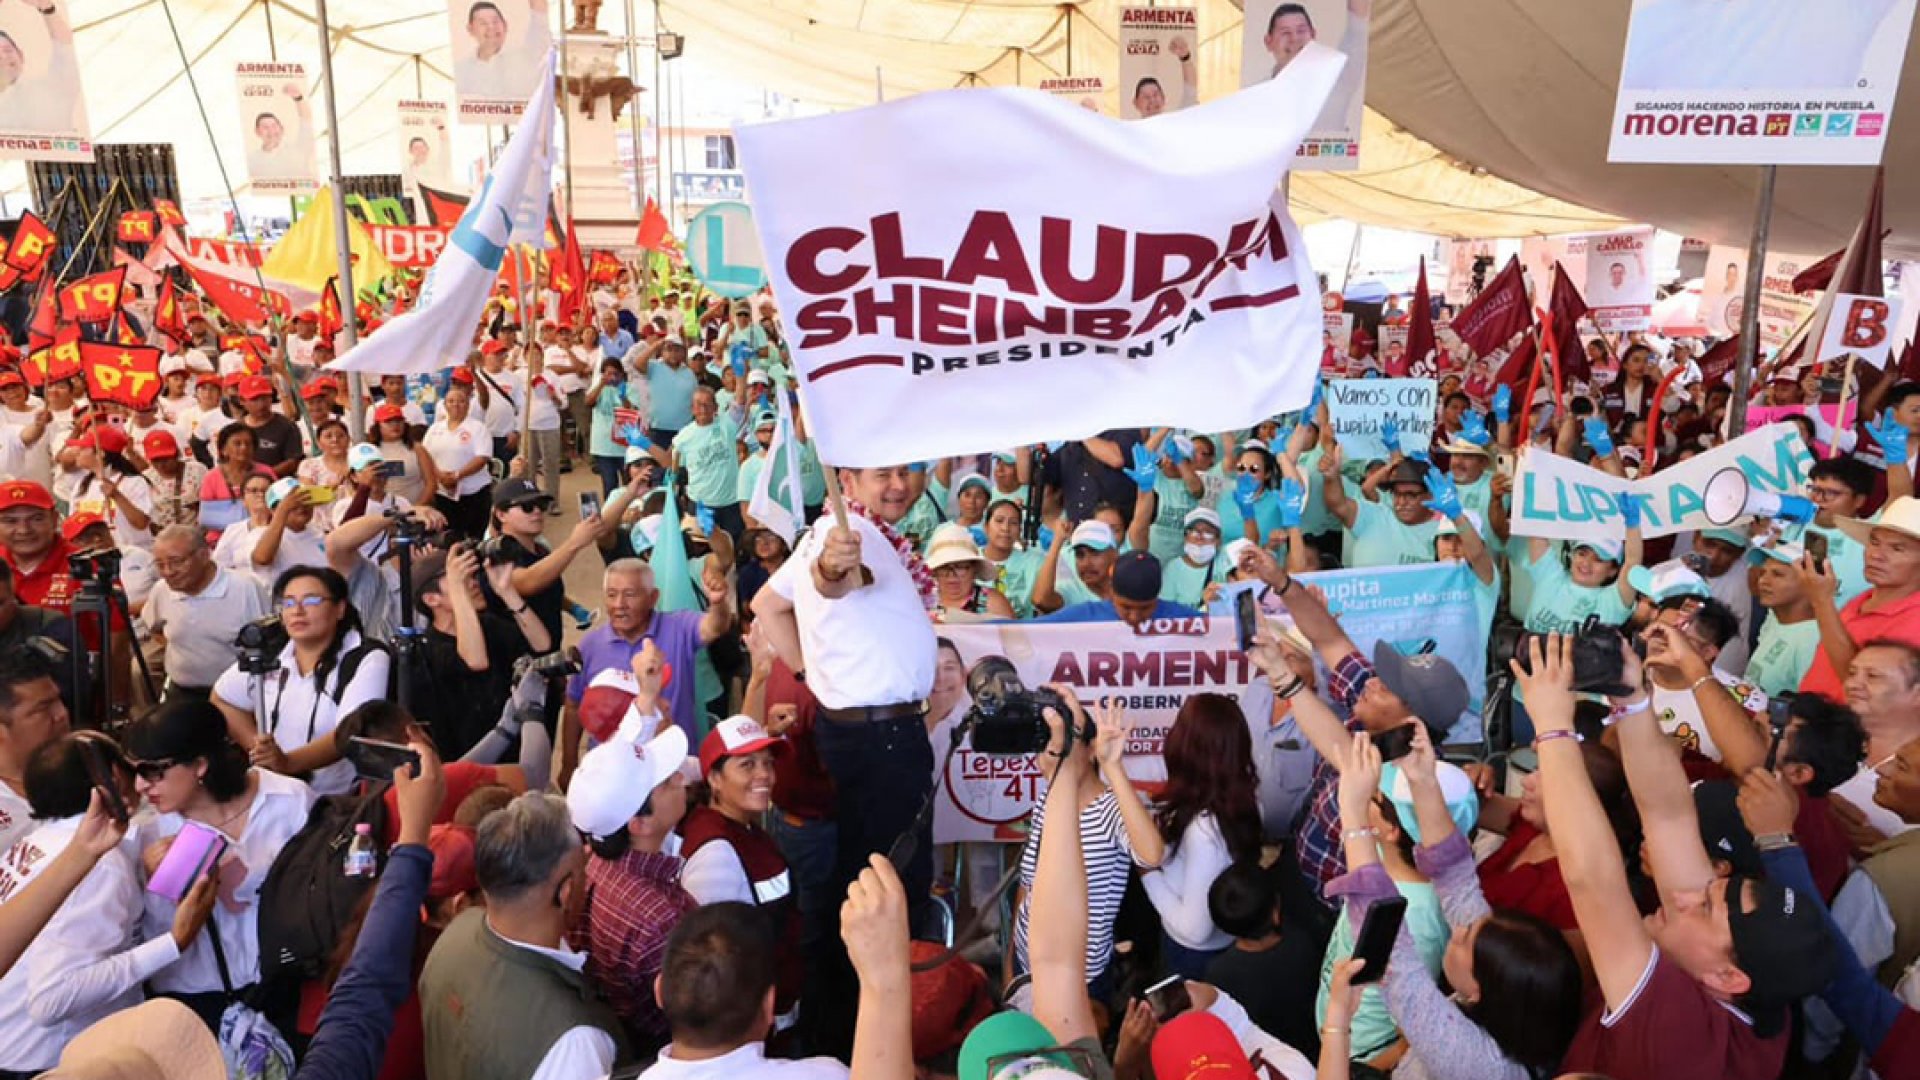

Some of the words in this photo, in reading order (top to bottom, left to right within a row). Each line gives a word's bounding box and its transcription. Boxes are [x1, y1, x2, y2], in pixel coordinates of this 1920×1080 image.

[1122, 9, 1195, 24] ARMENTA
[236, 63, 304, 74] ARMENTA
[1040, 78, 1102, 90] ARMENTA
[459, 104, 511, 114] morena
[1635, 102, 1684, 111] SIGAMOS
[1686, 102, 1745, 111] HACIENDO
[1747, 102, 1801, 111] HISTORIA
[1804, 102, 1823, 111] EN
[1825, 101, 1875, 111] PUEBLA
[1623, 113, 1758, 136] morena
[796, 283, 1185, 349] SHEINBA
[93, 363, 157, 397] PT
[1332, 384, 1391, 406] Vamos
[1396, 386, 1431, 408] con
[1522, 472, 1706, 527] LUPTA
[1324, 578, 1380, 602] upita
[1138, 617, 1206, 634] VOTA
[1050, 651, 1250, 687] ARMENT
[1003, 773, 1044, 802] 4T
